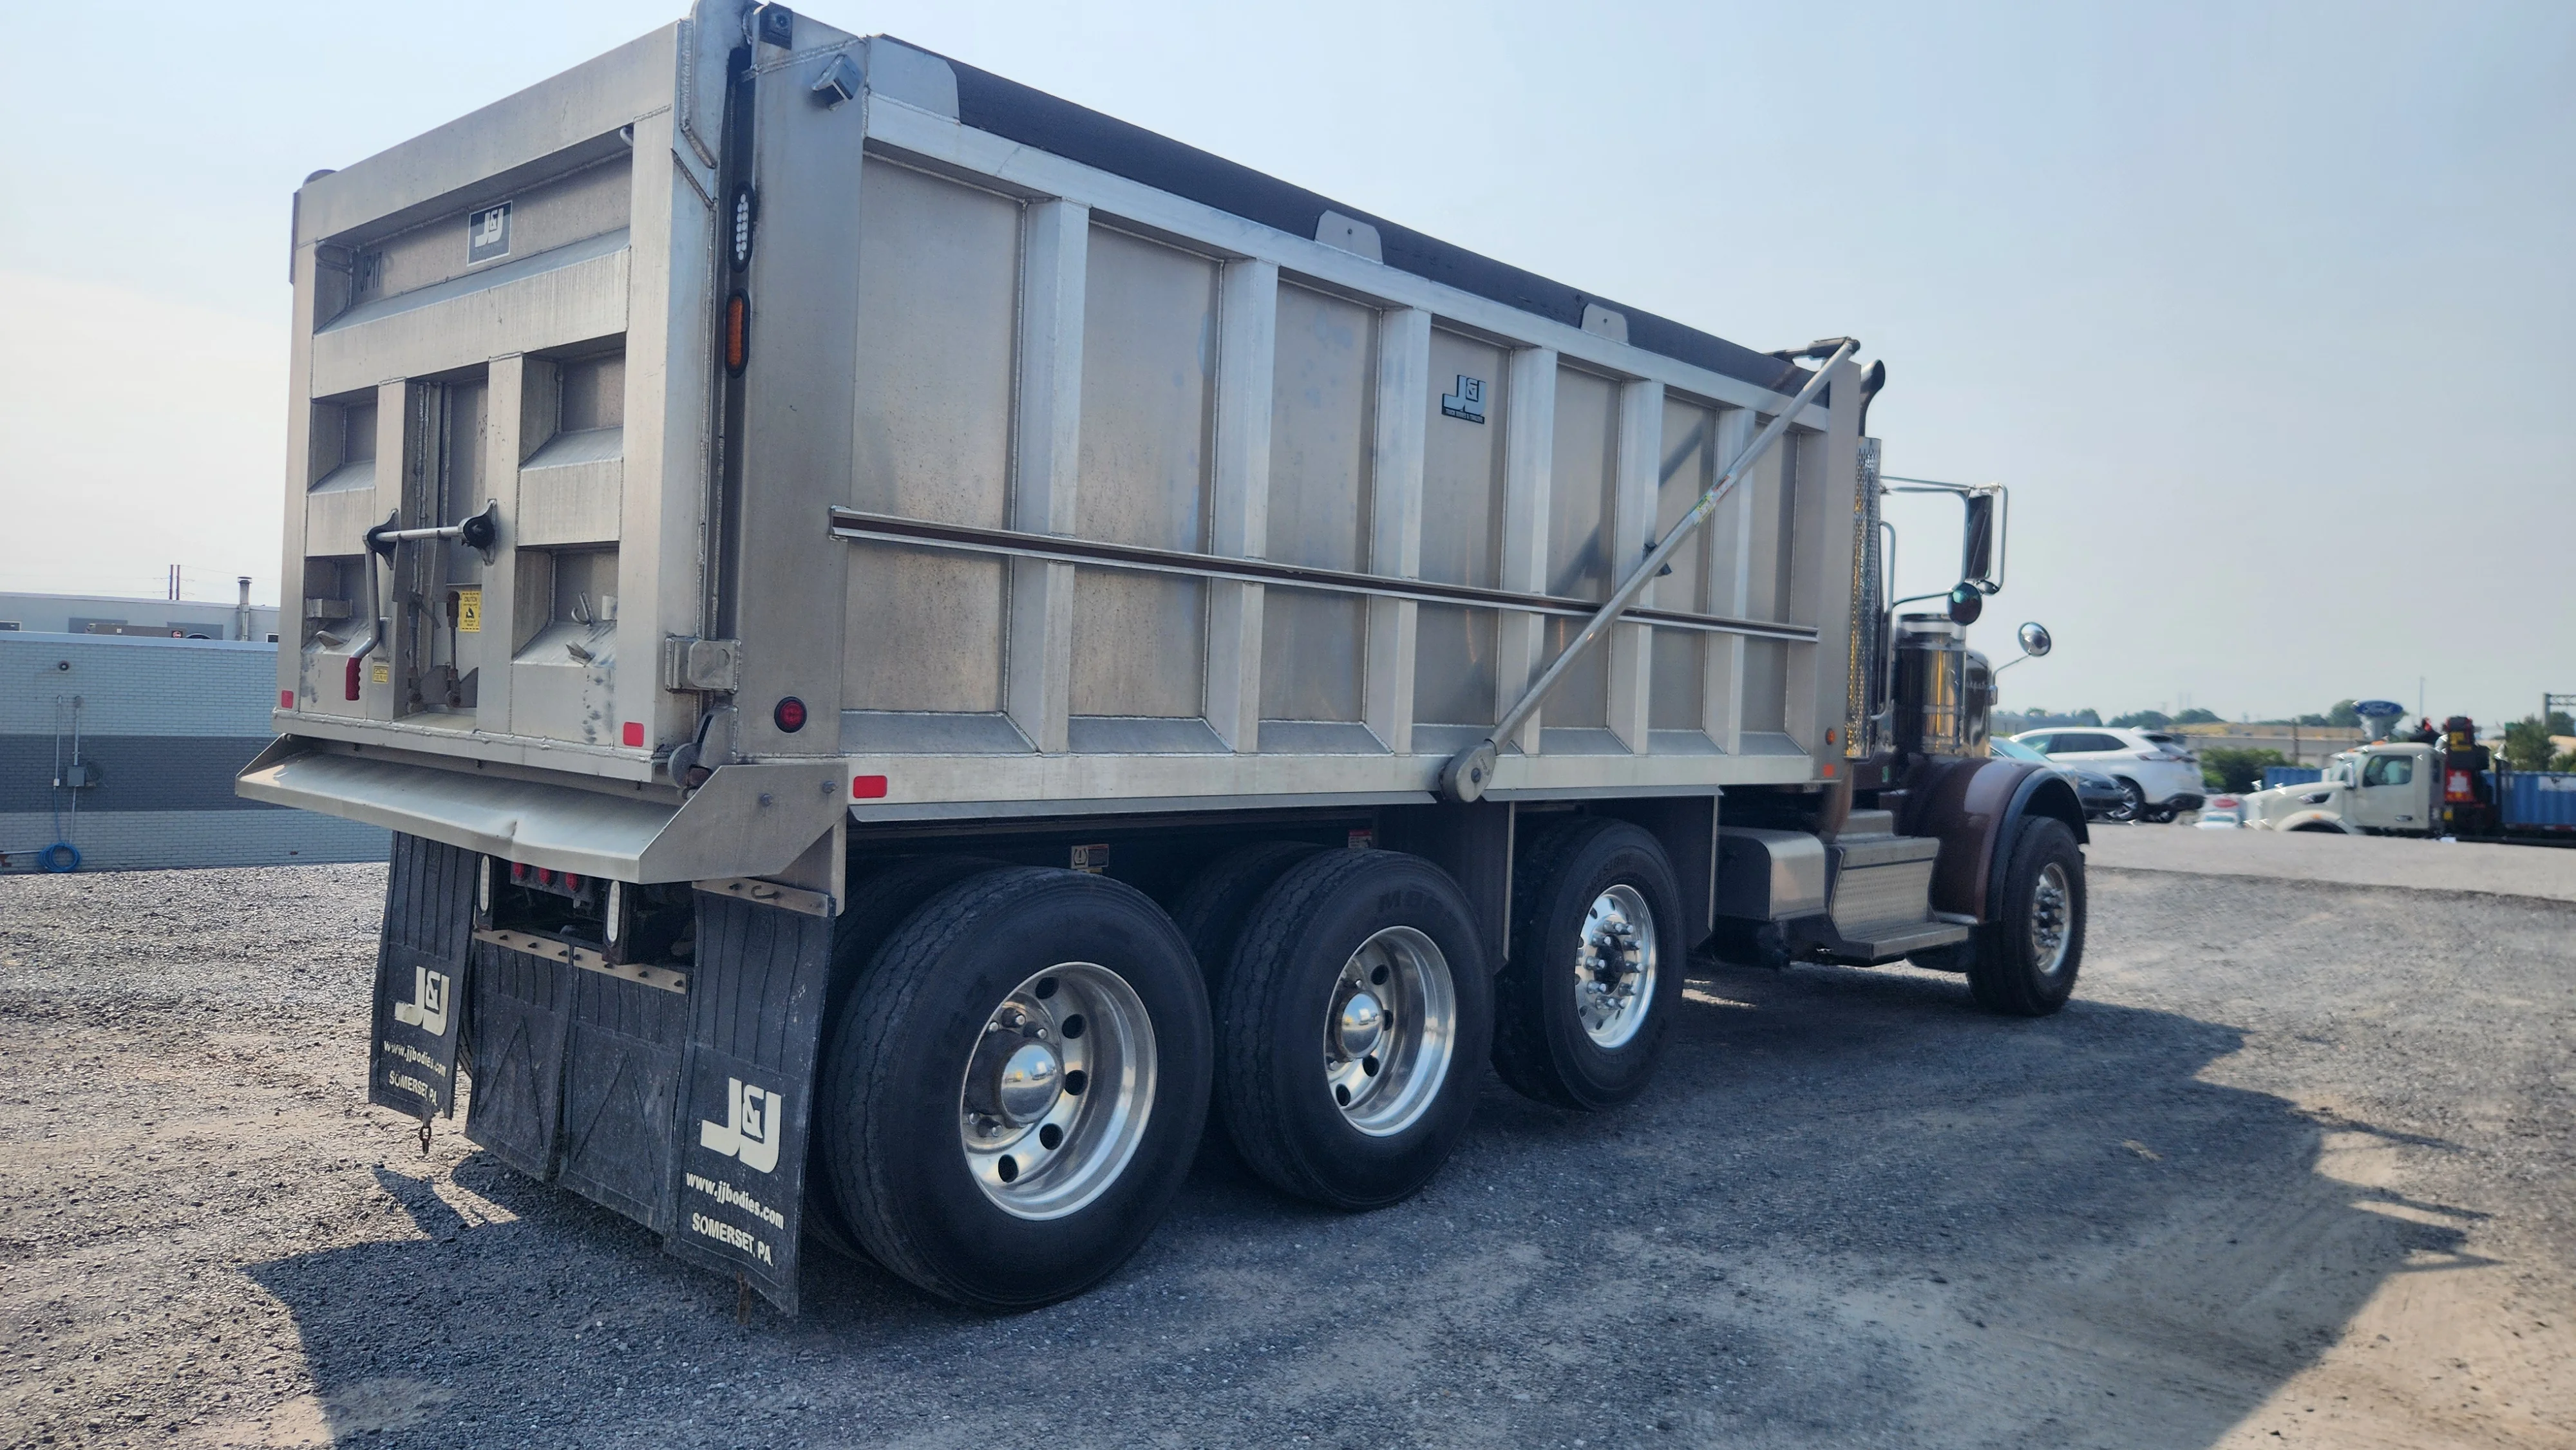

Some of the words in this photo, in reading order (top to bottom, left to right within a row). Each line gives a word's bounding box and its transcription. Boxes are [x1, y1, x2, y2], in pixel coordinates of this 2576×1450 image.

[475, 207, 504, 247] J&J
[1442, 375, 1486, 416] J&J
[394, 966, 450, 1037] J&J
[383, 1040, 447, 1078] www.jjbodies.com
[700, 1077, 782, 1174] J&J
[686, 1172, 785, 1230] www.jjbodies.com
